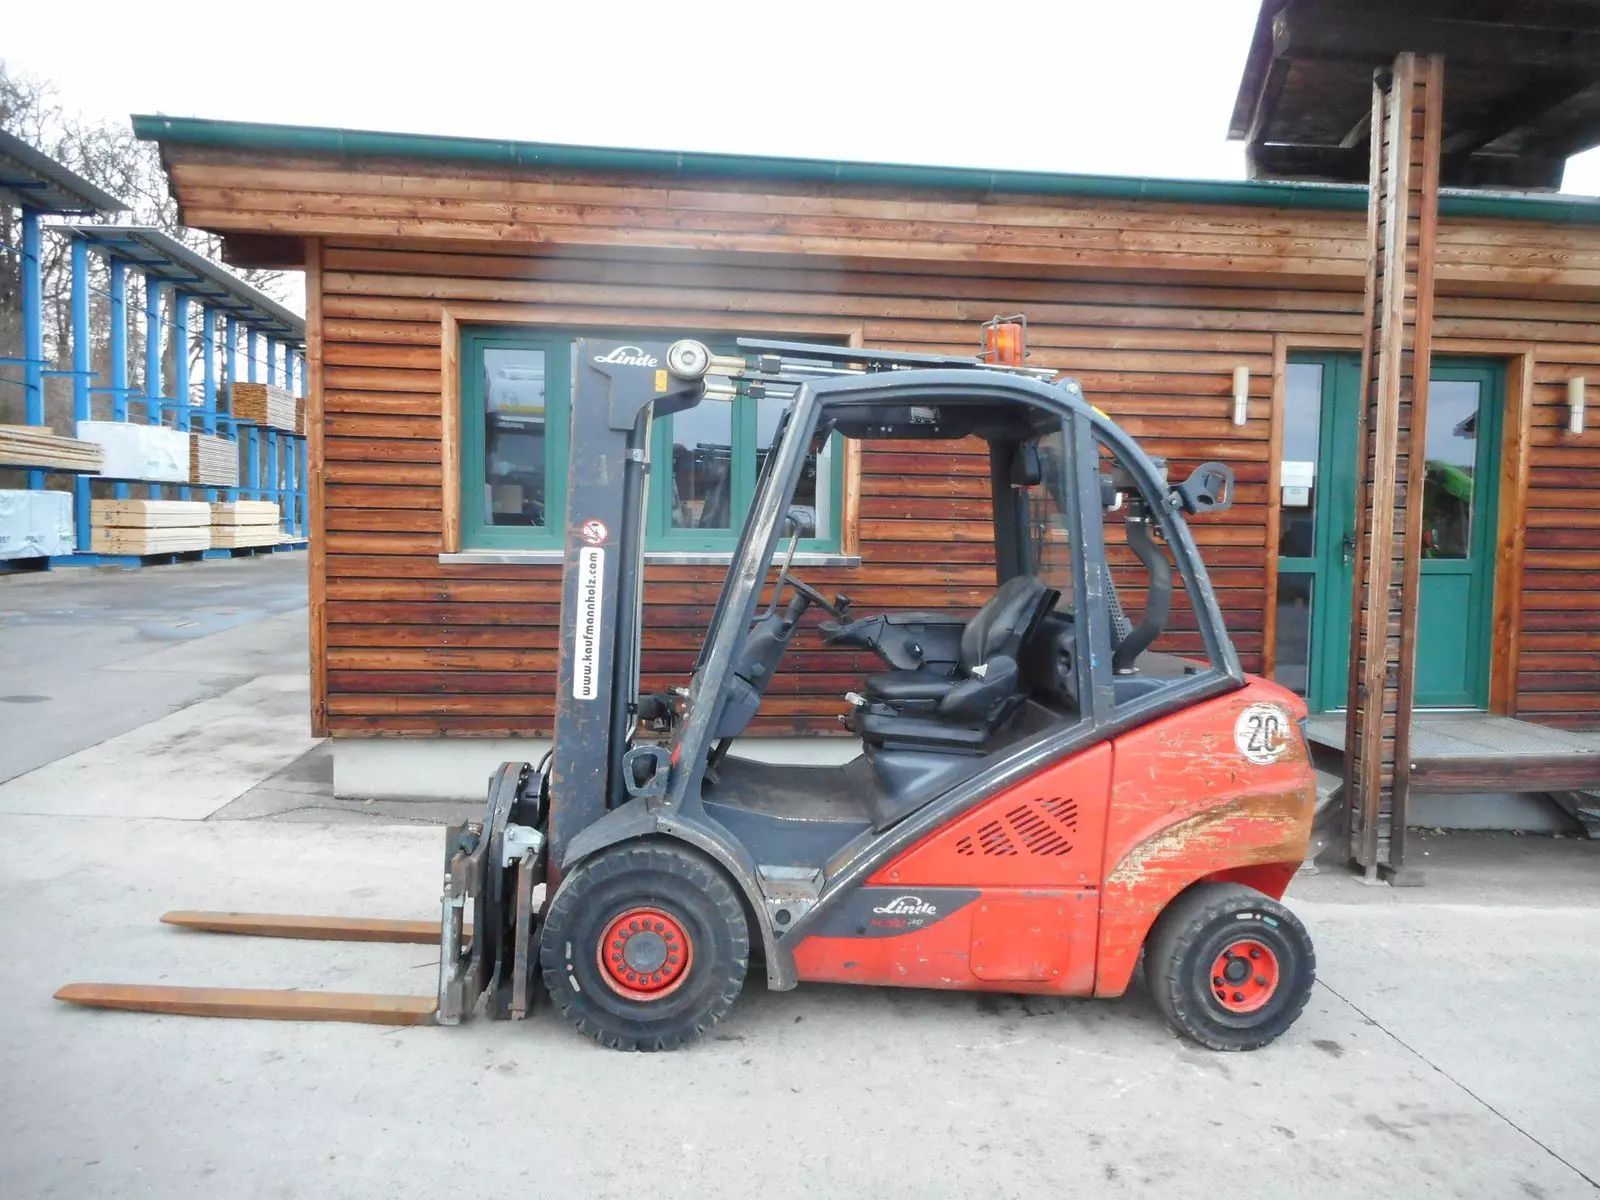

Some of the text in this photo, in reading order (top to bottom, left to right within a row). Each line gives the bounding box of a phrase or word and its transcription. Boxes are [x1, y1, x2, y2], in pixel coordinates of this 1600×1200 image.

[594, 345, 658, 368] Linde
[582, 552, 598, 696] www.kaufmannholz.com
[1247, 714, 1279, 752] 20
[873, 895, 937, 915] Linde
